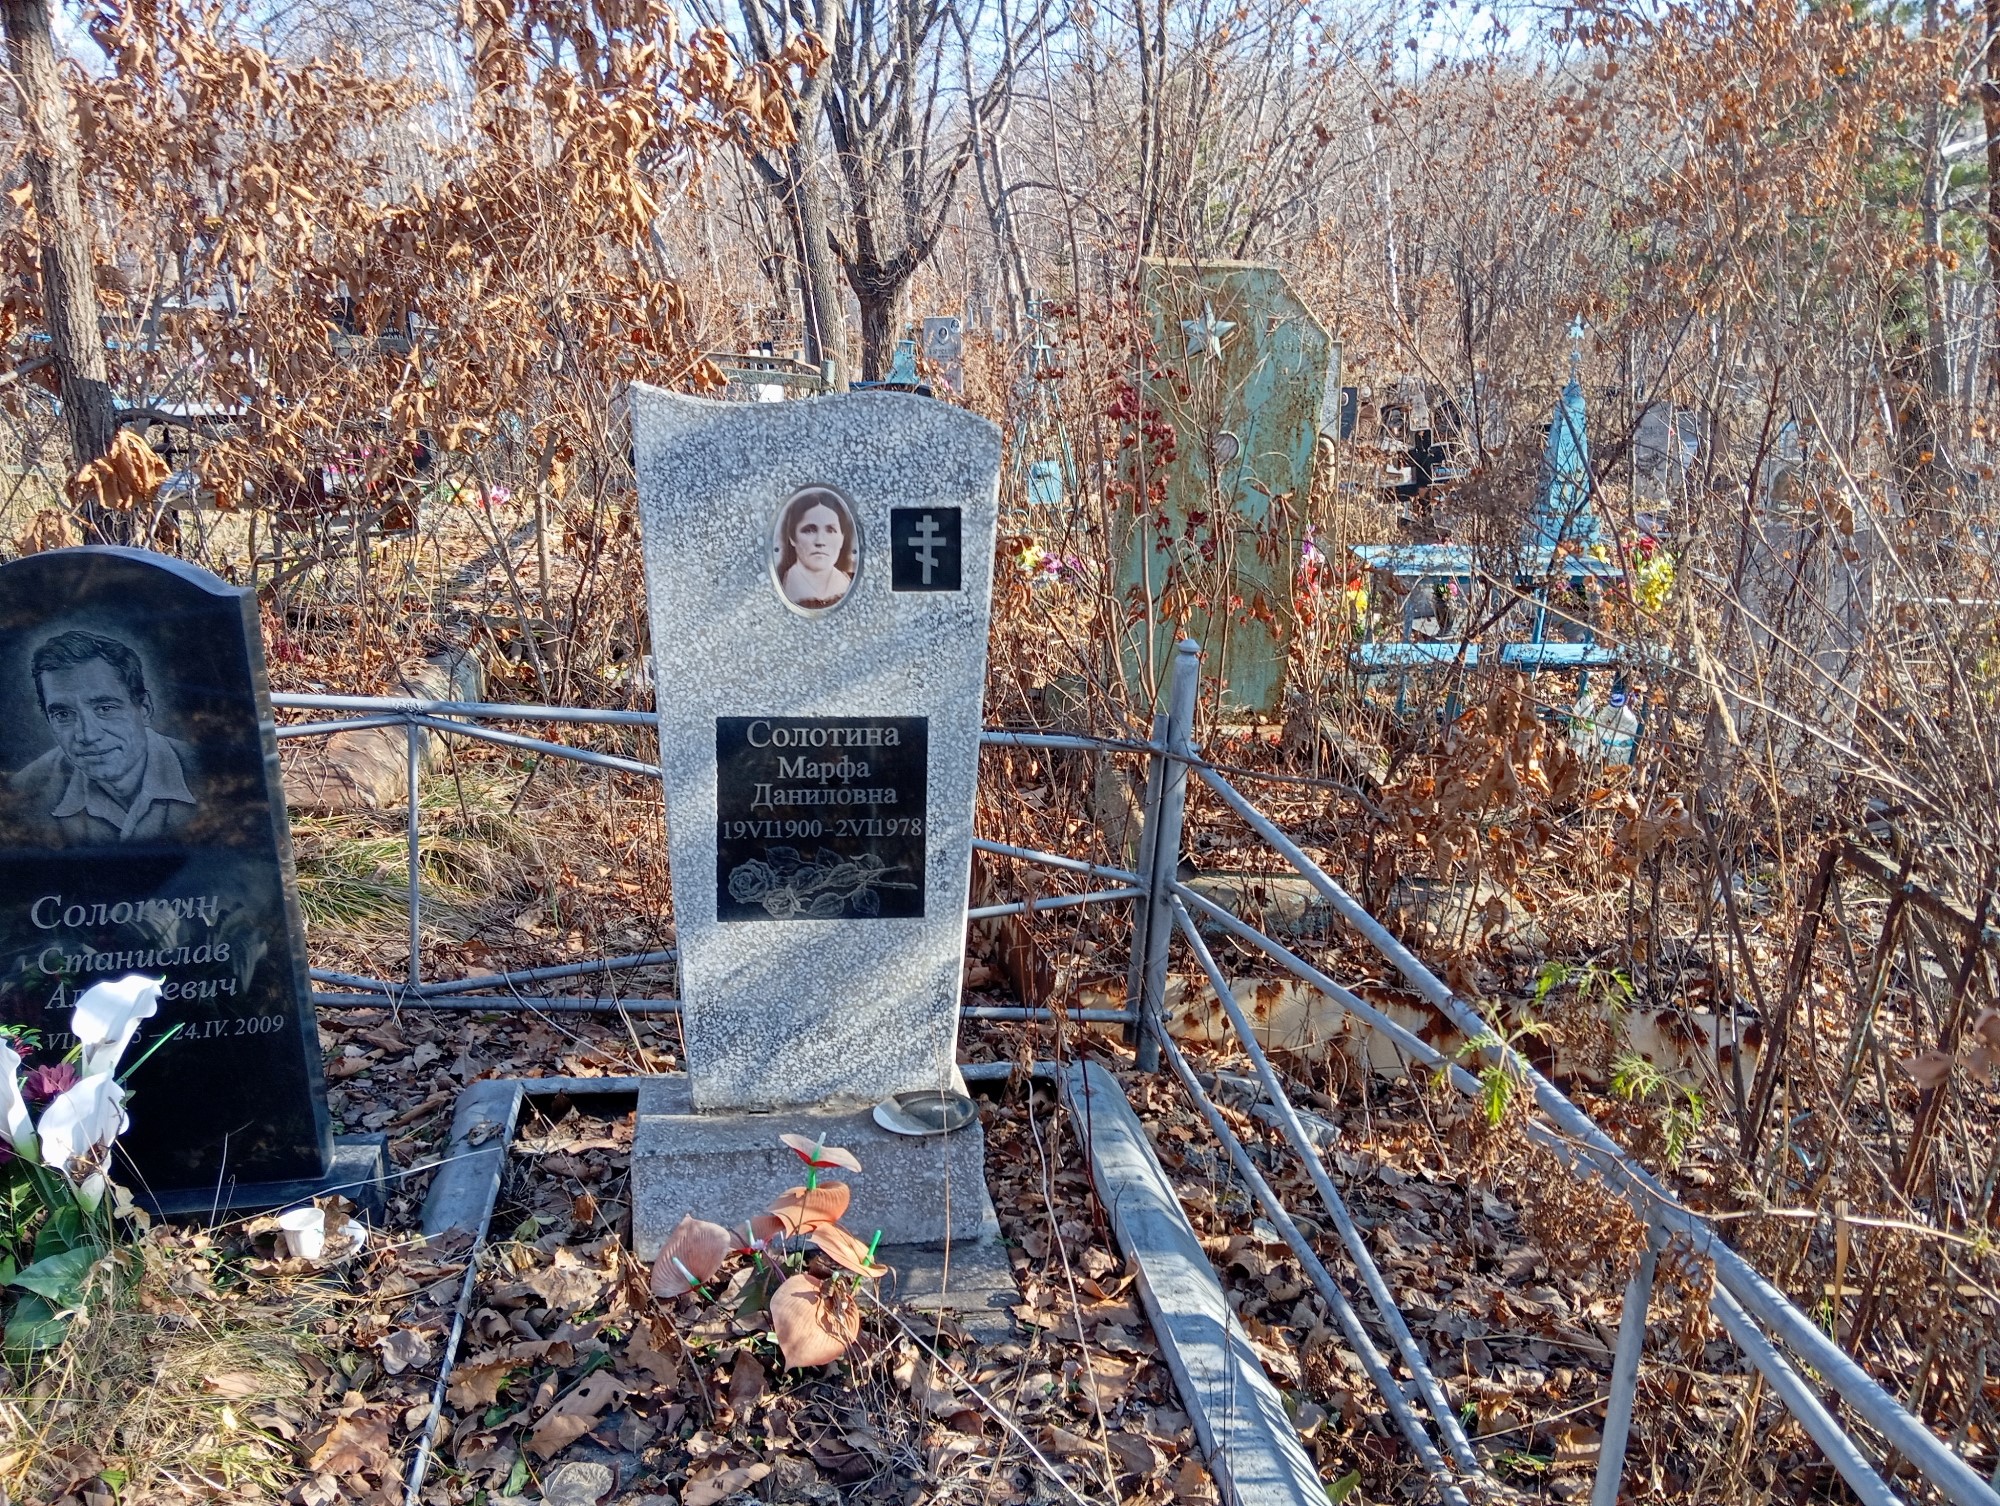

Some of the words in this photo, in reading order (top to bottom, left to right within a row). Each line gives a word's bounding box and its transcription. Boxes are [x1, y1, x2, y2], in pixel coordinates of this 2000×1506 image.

[747, 720, 900, 748] Солотина
[777, 756, 871, 785] Марфа
[750, 783, 898, 812] Даниловна
[31, 894, 219, 929] Солотин
[38, 942, 230, 975] Станислав
[44, 976, 237, 1010] Алевич
[234, 1014, 285, 1036] 2009
